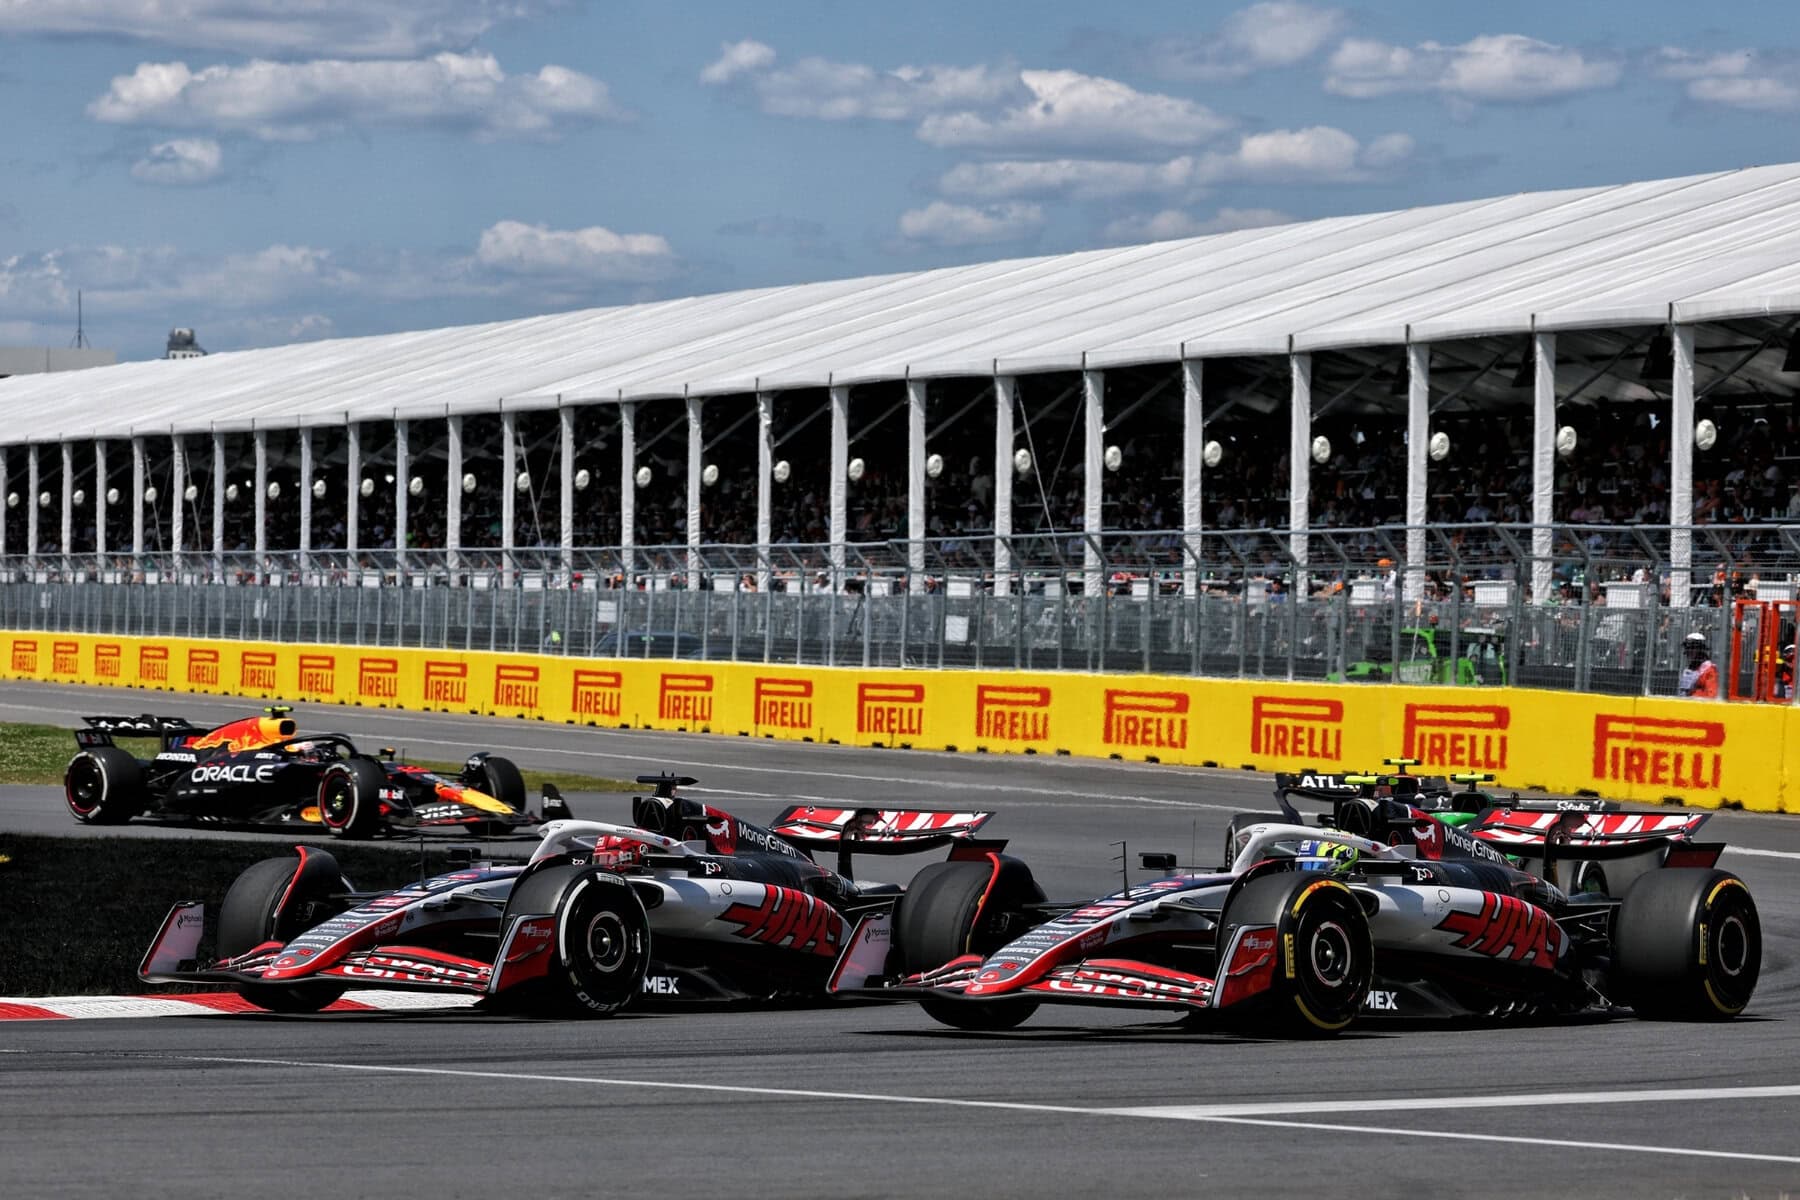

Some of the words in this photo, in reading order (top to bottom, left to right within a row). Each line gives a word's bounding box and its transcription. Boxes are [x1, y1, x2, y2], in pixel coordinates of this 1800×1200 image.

[95, 645, 120, 677] PIRELLI
[139, 646, 168, 681] PIRELLI
[188, 649, 219, 685] PIRELLI
[241, 652, 276, 689] PIRELLI
[299, 655, 335, 694] PIRELLI
[359, 658, 398, 698] PIRELLI
[424, 661, 467, 703] PIRELLI
[494, 664, 539, 709] PIRELLI
[572, 669, 622, 717] PIRELLI
[659, 673, 713, 722] PIRELLI
[754, 677, 813, 729] PIRELLI
[857, 683, 925, 736] PIRELLI
[976, 684, 1051, 741] PIRELLI
[1103, 689, 1190, 750] PIRELLI
[1251, 696, 1343, 760] PIRELLI
[1402, 703, 1510, 770] PIRELLI
[155, 752, 197, 763] HONDA
[1593, 714, 1726, 789] PIRELLI
[192, 764, 275, 783] ORACLE
[416, 804, 464, 819] VISA
[1557, 800, 1591, 812] Stake
[738, 822, 797, 858] MoneyGram
[1443, 825, 1503, 865] MoneyGram
[714, 883, 844, 958] HAAS
[1432, 889, 1562, 970] HAAS
[642, 976, 680, 995] MEX
